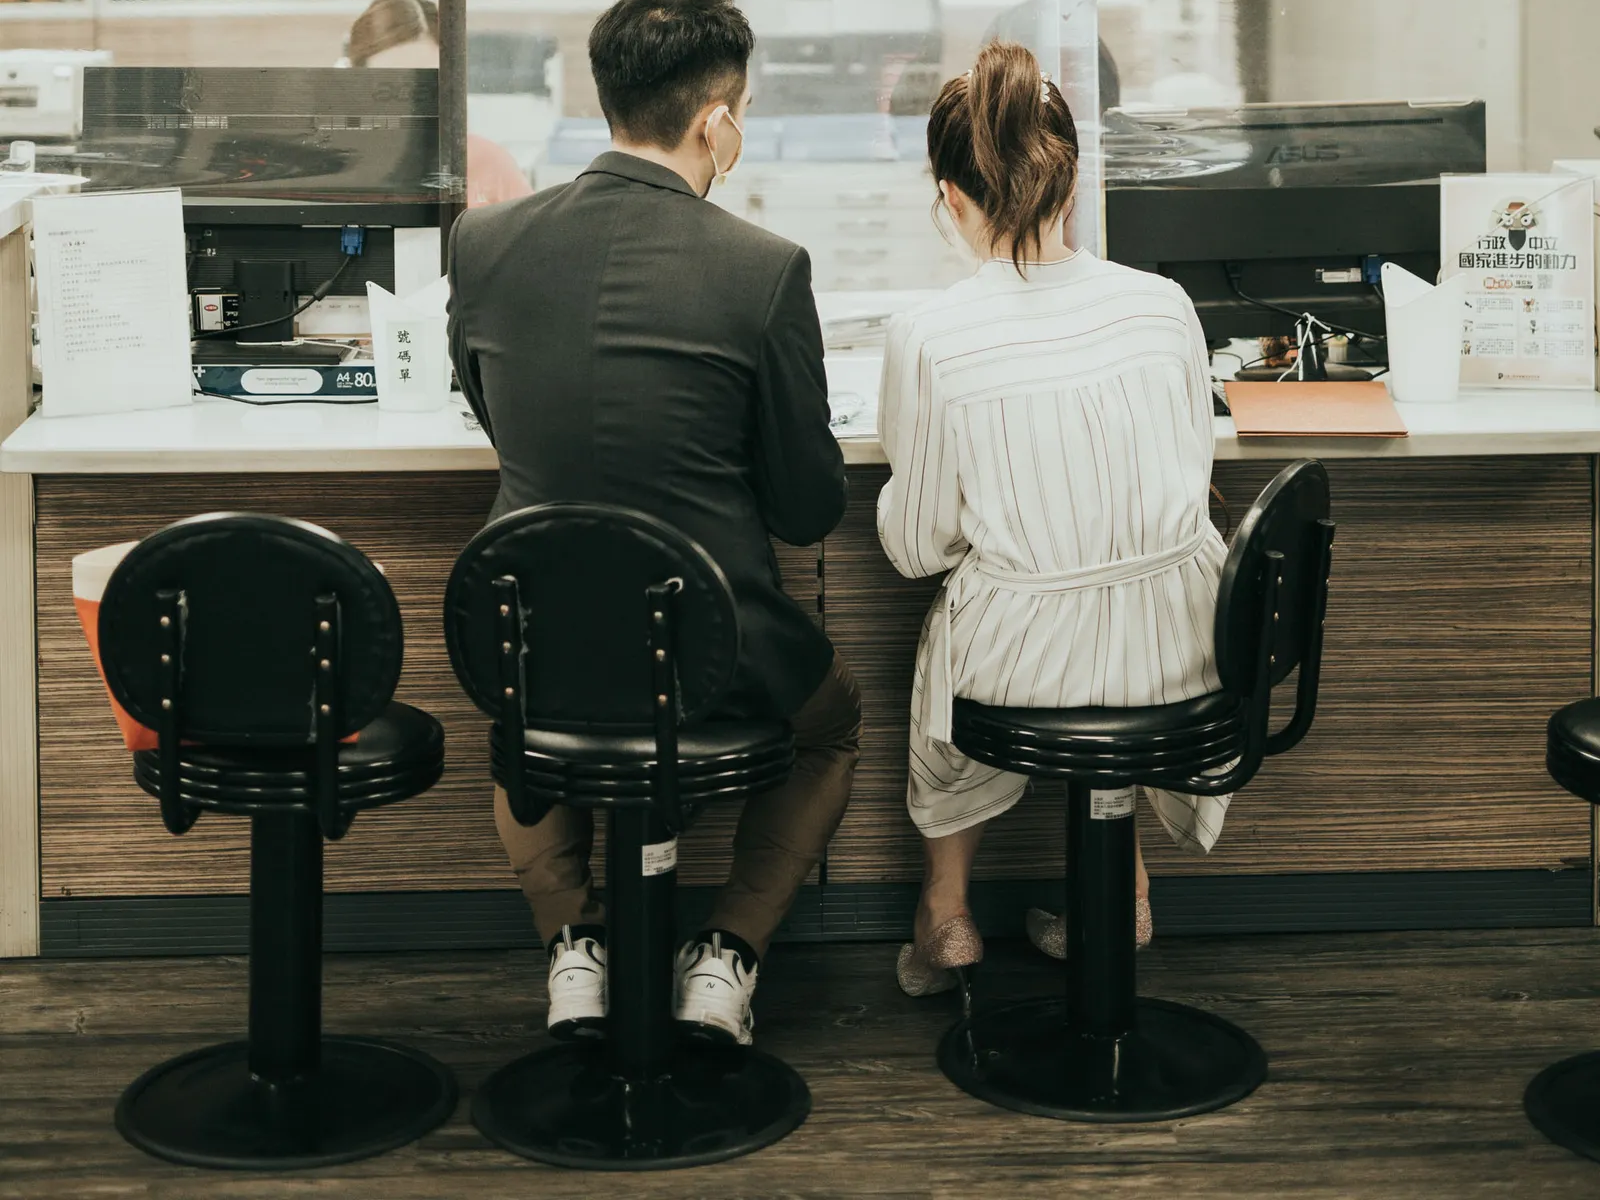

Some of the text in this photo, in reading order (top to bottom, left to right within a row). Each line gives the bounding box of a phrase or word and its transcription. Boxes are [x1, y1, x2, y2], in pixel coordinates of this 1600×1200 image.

[1478, 235, 1558, 250] 行政 中立
[1459, 253, 1576, 269] 國家進步的動力
[397, 330, 411, 382] 號碼單
[336, 372, 350, 382] A4
